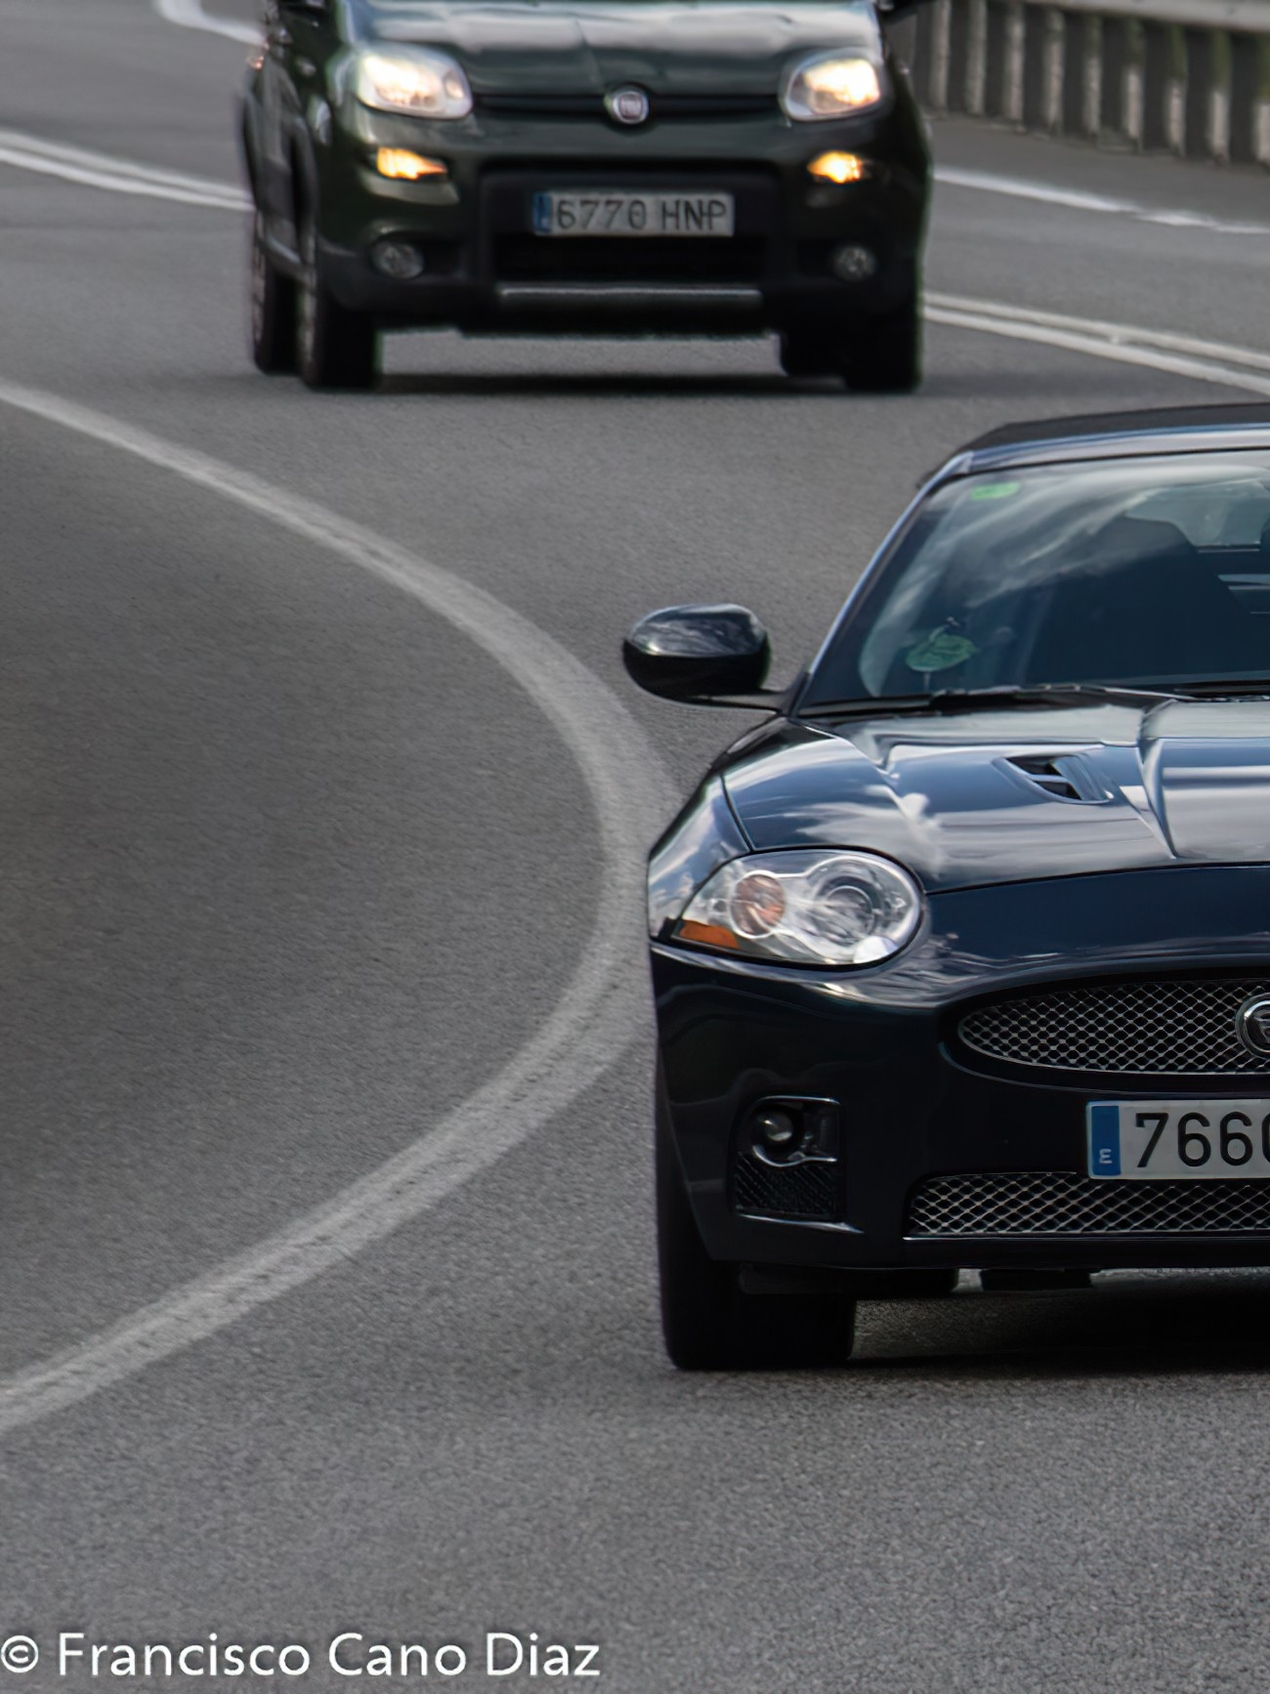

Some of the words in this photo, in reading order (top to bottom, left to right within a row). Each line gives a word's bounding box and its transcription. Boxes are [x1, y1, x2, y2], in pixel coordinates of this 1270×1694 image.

[557, 199, 647, 231] 6770
[661, 199, 727, 231] HNP
[1098, 1148, 1112, 1165] E
